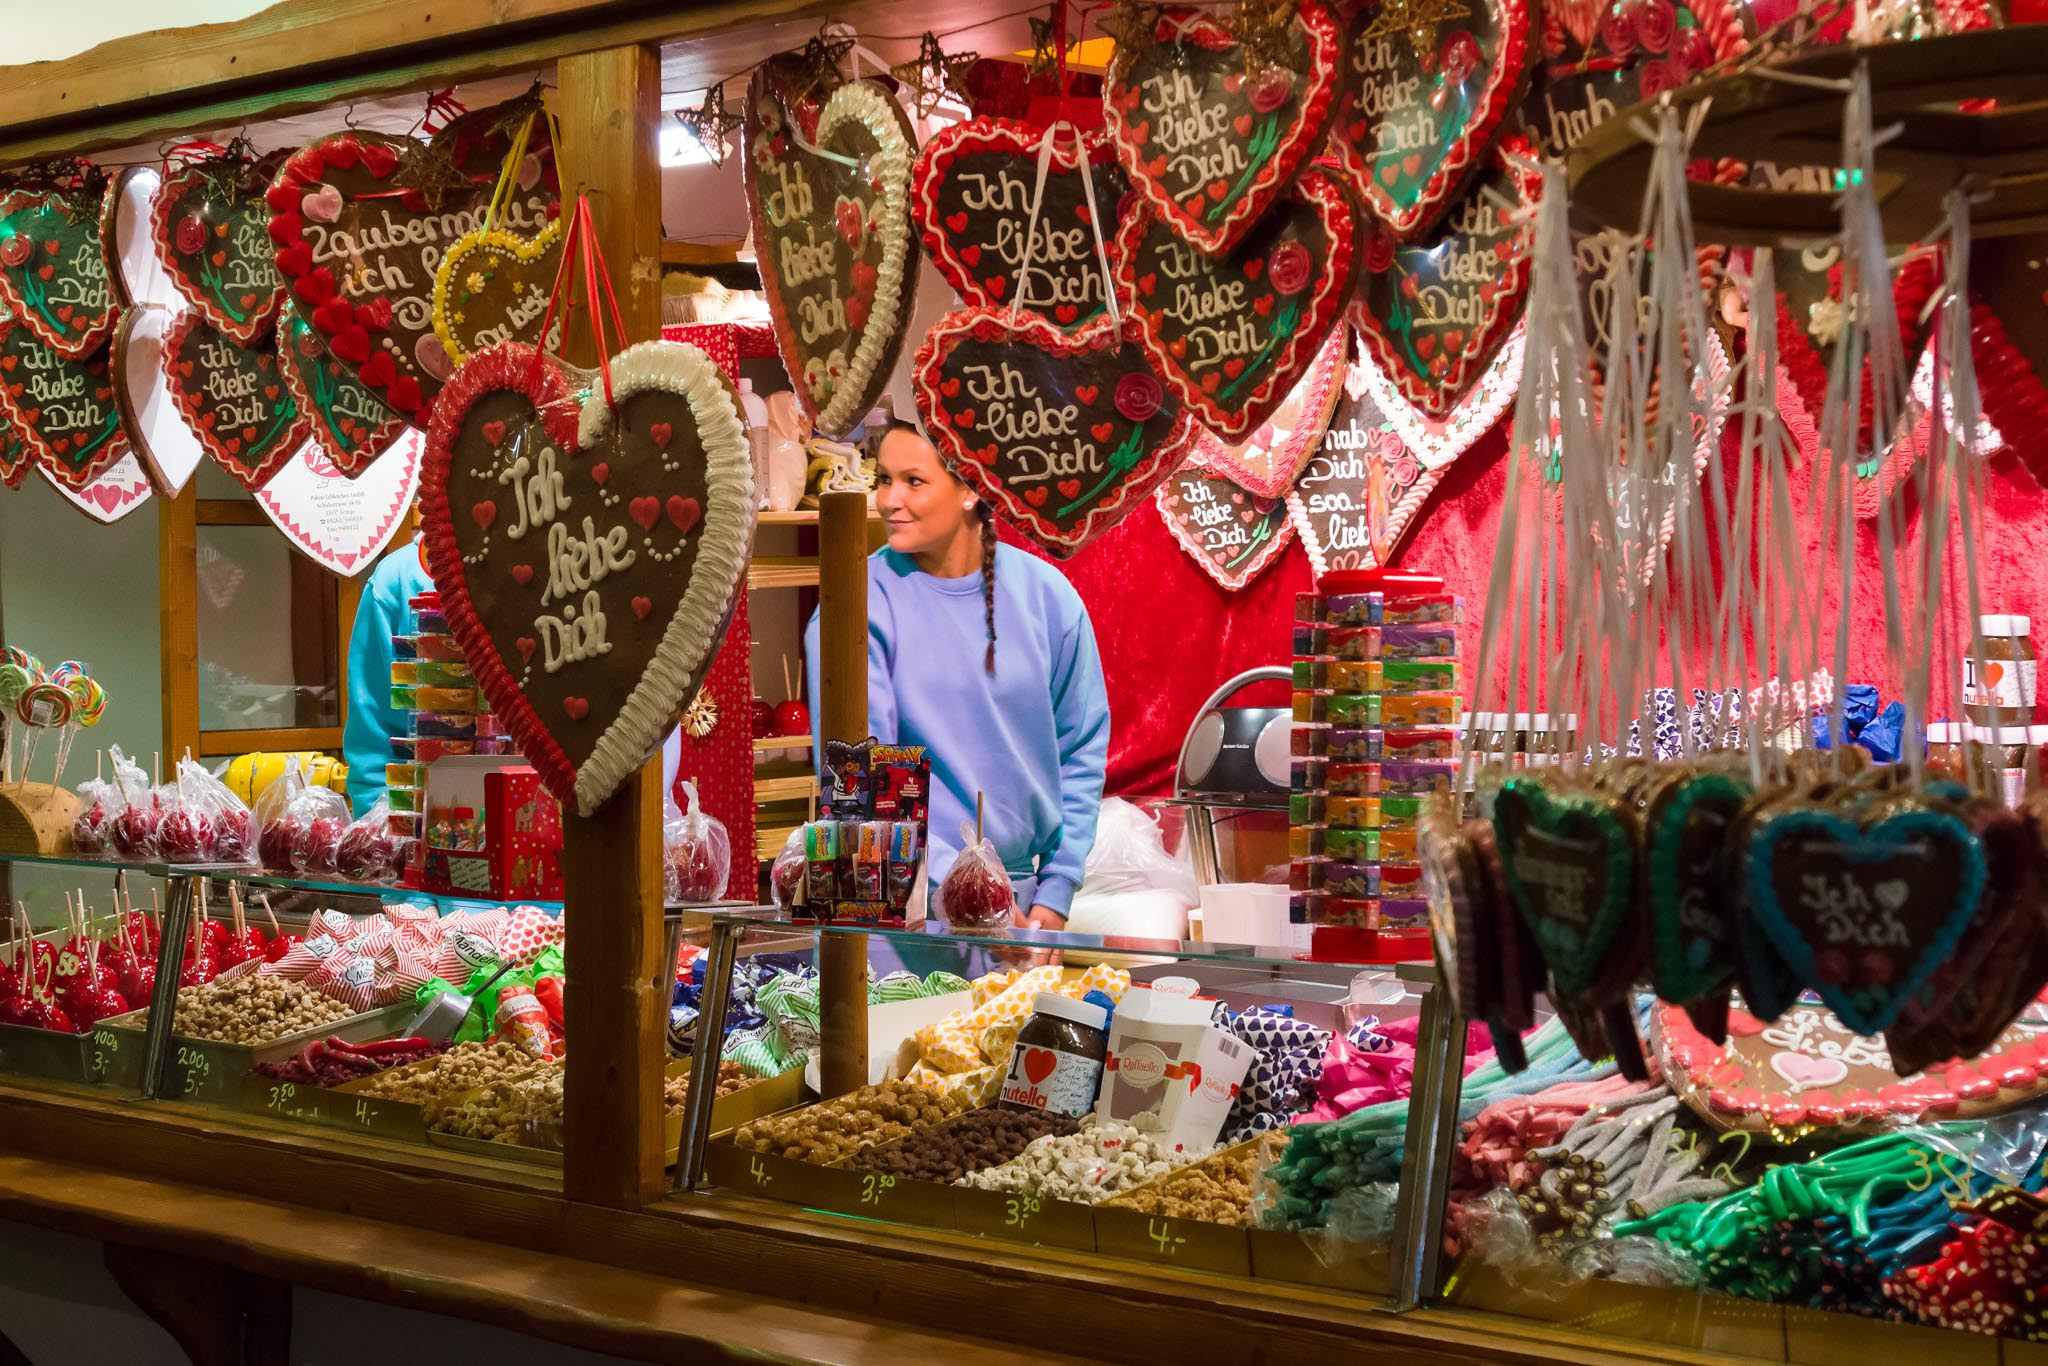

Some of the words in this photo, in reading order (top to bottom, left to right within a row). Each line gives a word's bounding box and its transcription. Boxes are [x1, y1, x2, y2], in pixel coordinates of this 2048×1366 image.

[1352, 37, 1399, 74] Ich
[1142, 68, 1201, 113] Ich
[1354, 70, 1421, 117] liebe
[1152, 99, 1231, 153] liebe
[1366, 109, 1440, 164] Dich
[1167, 138, 1248, 202] Dich
[957, 170, 1034, 215] Ich
[780, 225, 838, 288] liebe
[980, 216, 1091, 265] liebe
[224, 259, 282, 291] Dich
[344, 255, 414, 297] ich
[1155, 242, 1214, 279] Ich
[48, 277, 114, 308] Dich
[1009, 264, 1106, 308] Dich
[1163, 275, 1248, 326] liebe
[1413, 282, 1487, 328] Dich
[506, 283, 551, 331] bist
[798, 278, 847, 345] Dich
[19, 341, 66, 369] Ich
[199, 340, 242, 369] Ich
[1186, 314, 1268, 371] Dich
[25, 368, 85, 402] liebe
[202, 367, 257, 401] liebe
[962, 362, 1037, 401] Ich
[43, 398, 104, 433] Dich
[215, 396, 268, 431] Dich
[976, 402, 1080, 442] liebe
[1007, 439, 1104, 485] Dich
[1300, 451, 1366, 489] Dich
[498, 446, 573, 540] Ich
[1180, 481, 1216, 503] Ich
[1190, 496, 1234, 527] liebe
[1203, 526, 1250, 551] Dich
[541, 515, 636, 607] liebe
[534, 590, 614, 673] Dich
[94, 1031, 118, 1052] 100g
[178, 1047, 210, 1076] 200g
[1008, 1044, 1026, 1081] I
[1123, 1057, 1160, 1073] Raffaello
[1001, 1086, 1048, 1108] nutella
